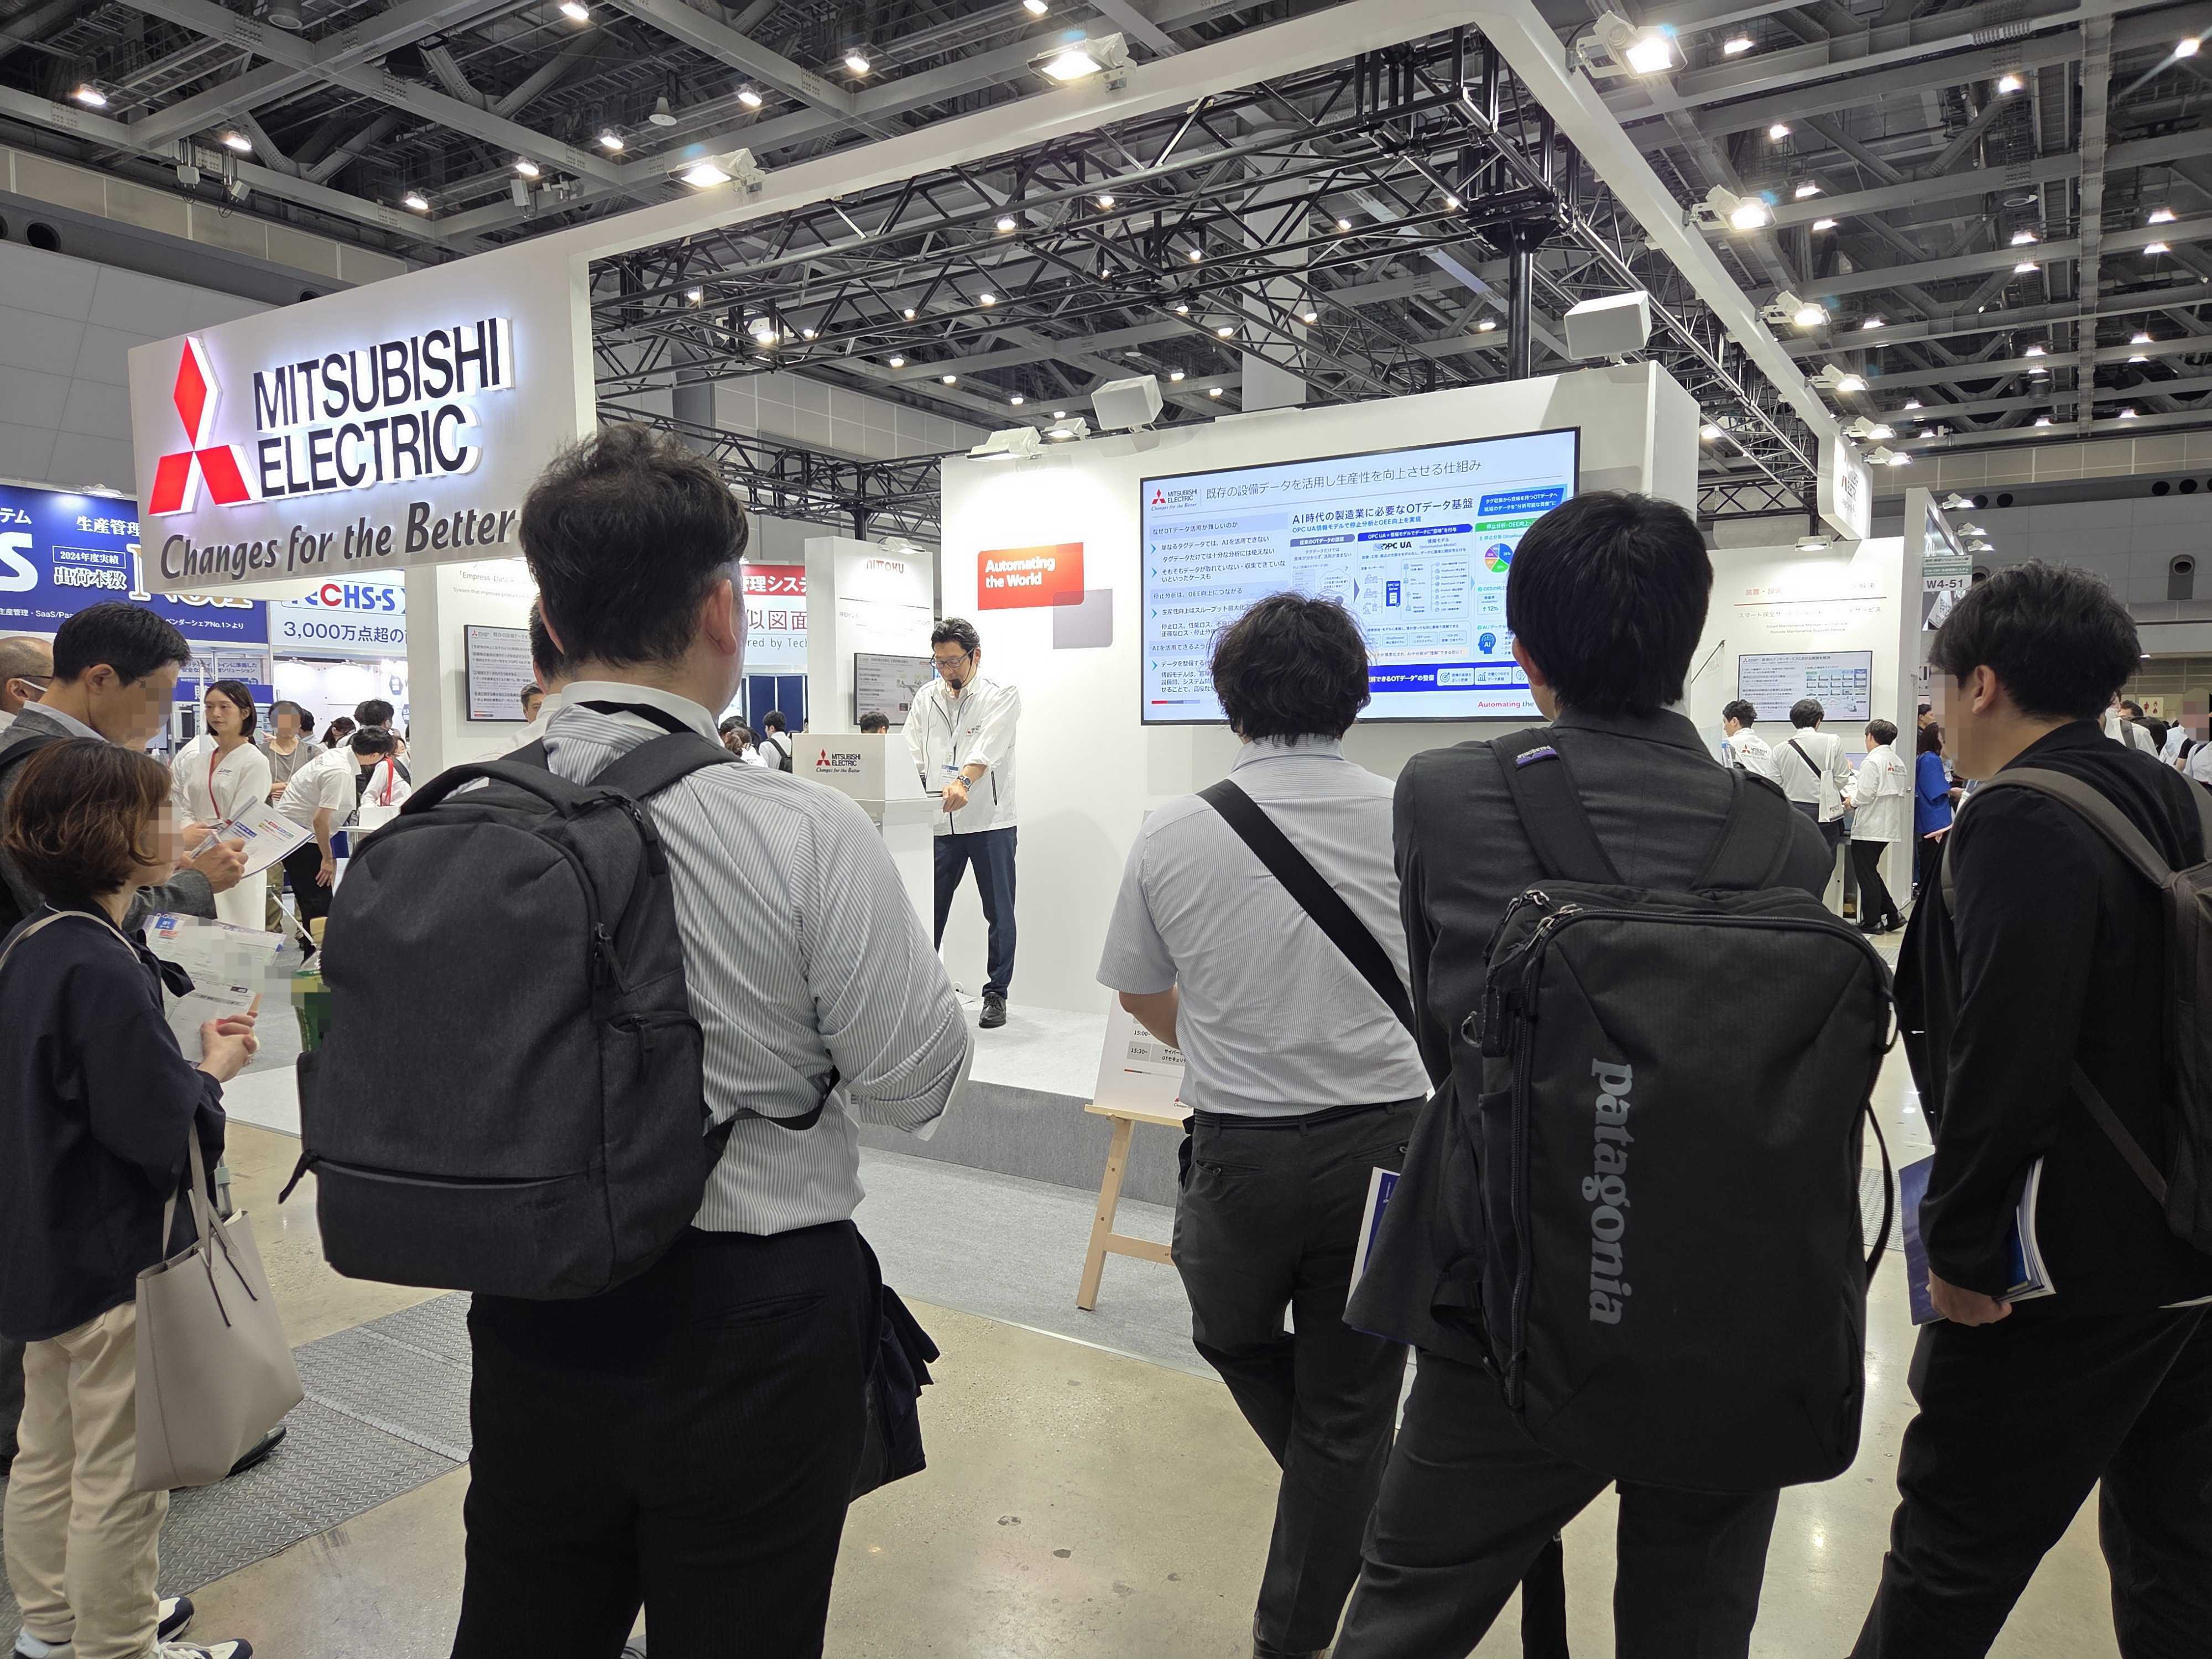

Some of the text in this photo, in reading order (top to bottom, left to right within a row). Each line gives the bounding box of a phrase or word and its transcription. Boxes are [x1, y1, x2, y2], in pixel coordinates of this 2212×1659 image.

[253, 317, 500, 431] MITSUBISHI
[257, 404, 468, 498] ELECTRIC
[1206, 460, 1481, 499] 既存の設備データを活用し生産性を向上させる仕組み
[1167, 488, 1197, 497] MITSUBISHI
[1292, 497, 1473, 524] AI時代の製造業に必要なOTデータ基盤
[1152, 521, 1238, 535] なぜOTデータ活用が難しいのか
[160, 534, 278, 581] Changes
[288, 524, 335, 572] for
[344, 517, 392, 560] the
[405, 502, 516, 554] Better
[1161, 536, 1269, 551] 単なるタグデータでは、AIを活用できない
[985, 556, 1056, 573] Automating
[985, 571, 1042, 588] the World
[1162, 573, 1211, 583] いといったケースも
[1926, 578, 1963, 589] W4-51
[291, 583, 395, 611] eCHS-S
[284, 621, 406, 643] 3,000万点超の
[747, 638, 764, 647] red
[770, 638, 782, 650] by
[1582, 1058, 1635, 1325] patagonia
